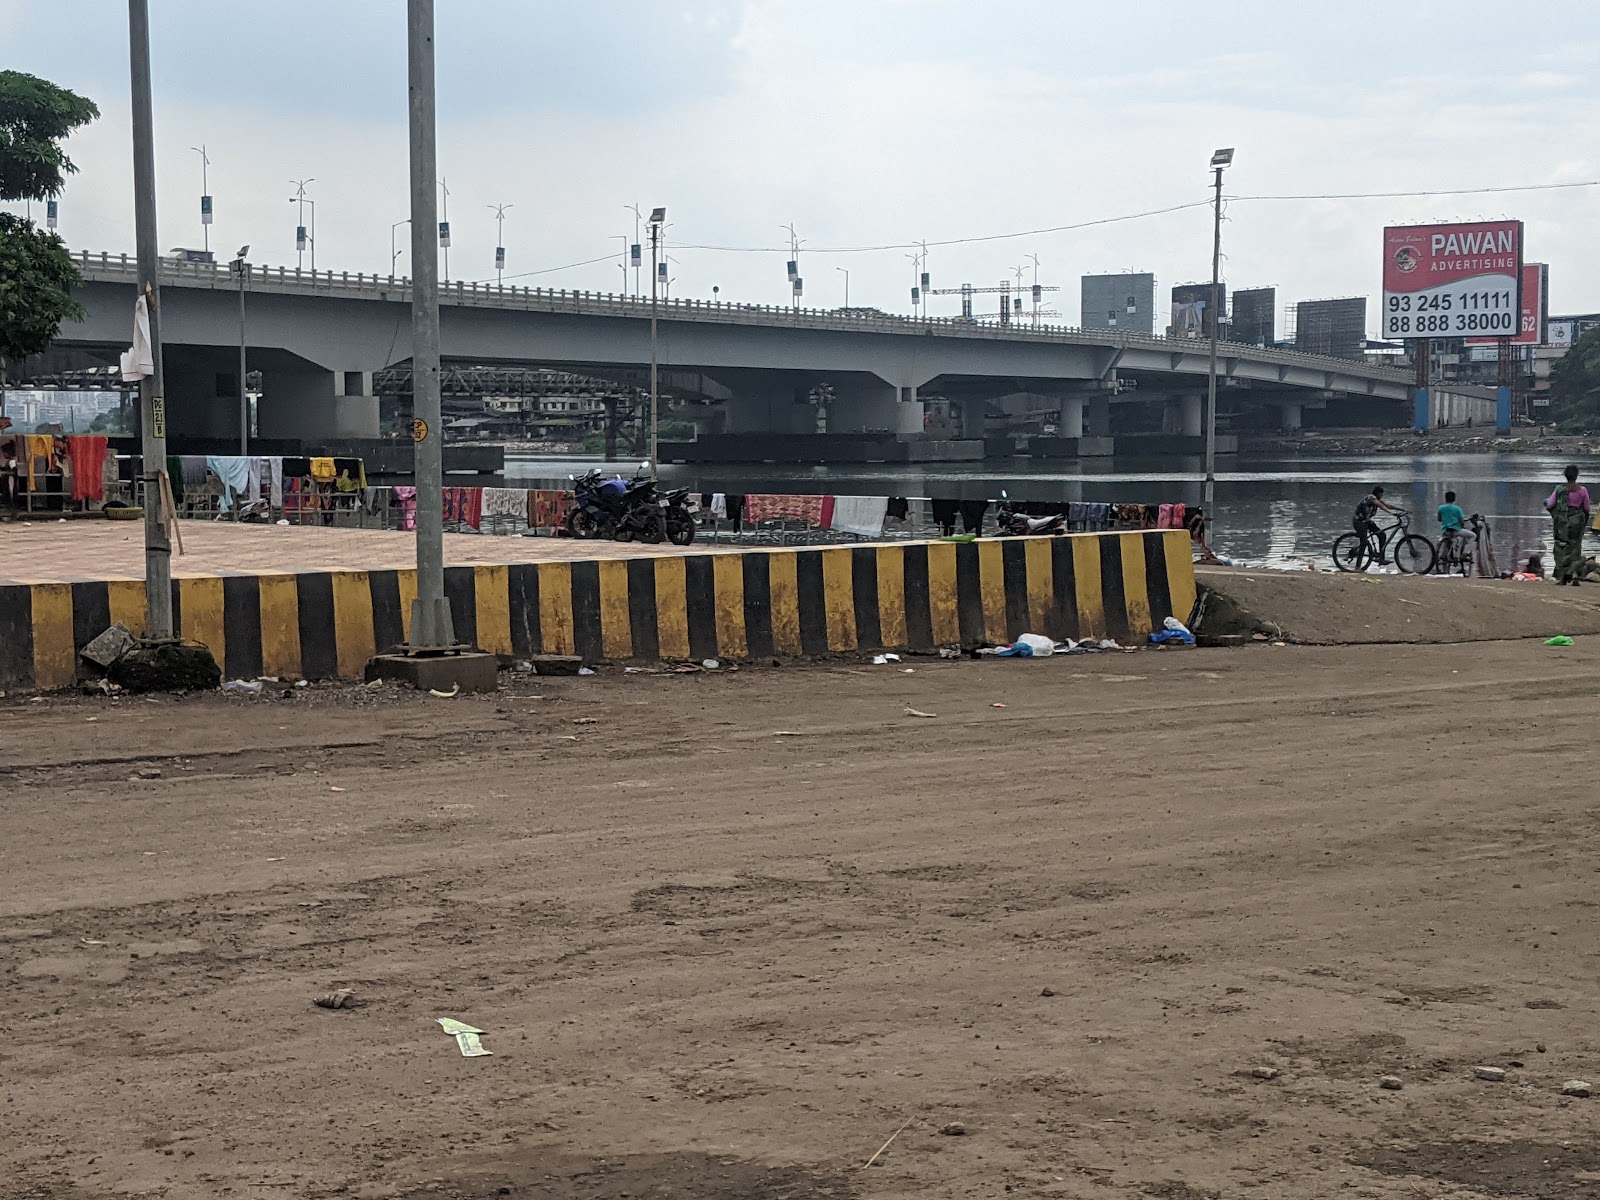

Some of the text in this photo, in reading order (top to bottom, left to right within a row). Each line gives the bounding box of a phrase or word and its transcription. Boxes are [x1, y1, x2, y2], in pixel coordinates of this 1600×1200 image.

[1431, 230, 1513, 256] PAWAN
[1431, 257, 1514, 271] ADVERTISING
[1389, 291, 1510, 312] 93 245 11111
[1390, 312, 1511, 333] 88 888 38000
